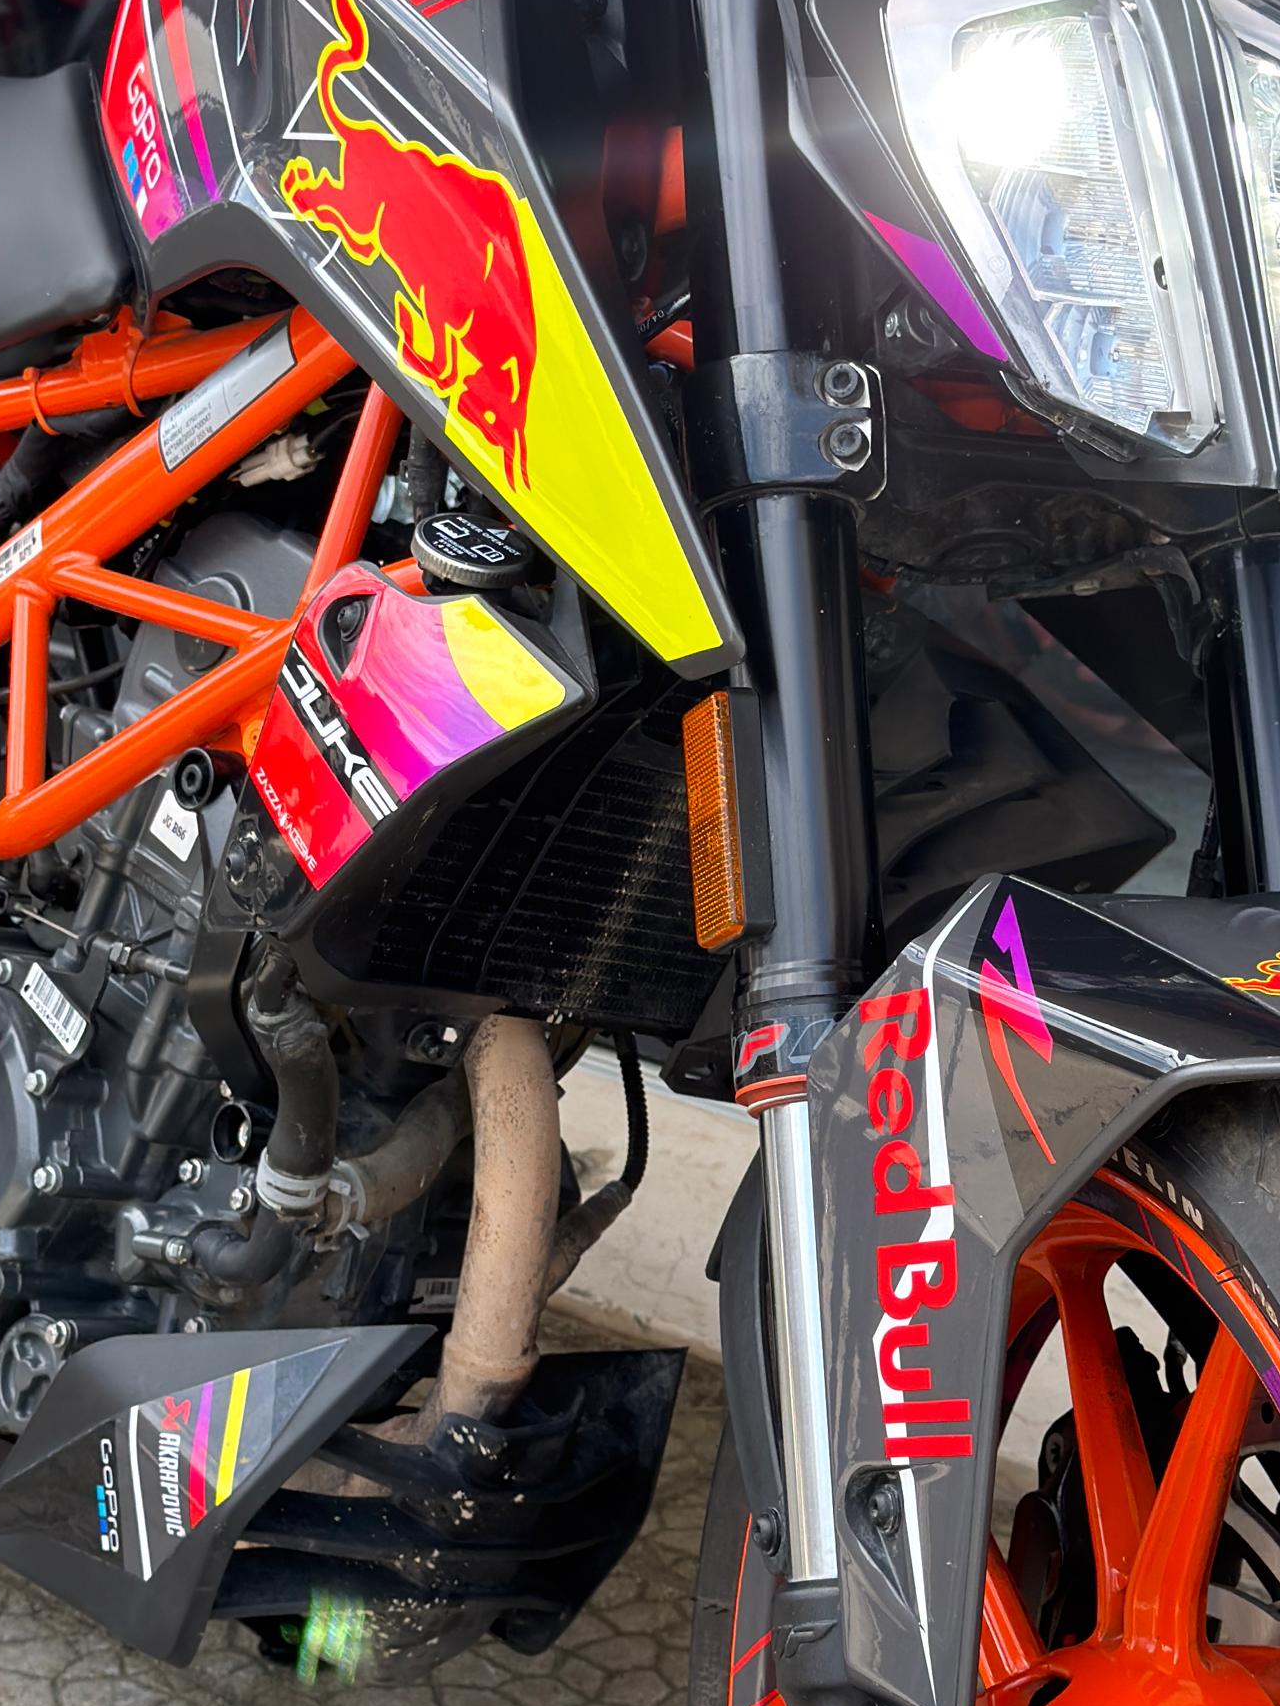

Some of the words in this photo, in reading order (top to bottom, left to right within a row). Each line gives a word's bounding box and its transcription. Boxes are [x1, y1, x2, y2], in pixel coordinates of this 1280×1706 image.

[127, 61, 161, 190] GoPro
[456, 516, 481, 534] NEVER
[481, 531, 503, 547] OPEN
[502, 543, 522, 557] HOT
[281, 663, 399, 821] DUKE
[859, 989, 956, 1215] Red
[876, 1238, 973, 1459] Bull
[100, 1438, 120, 1553] GoPro
